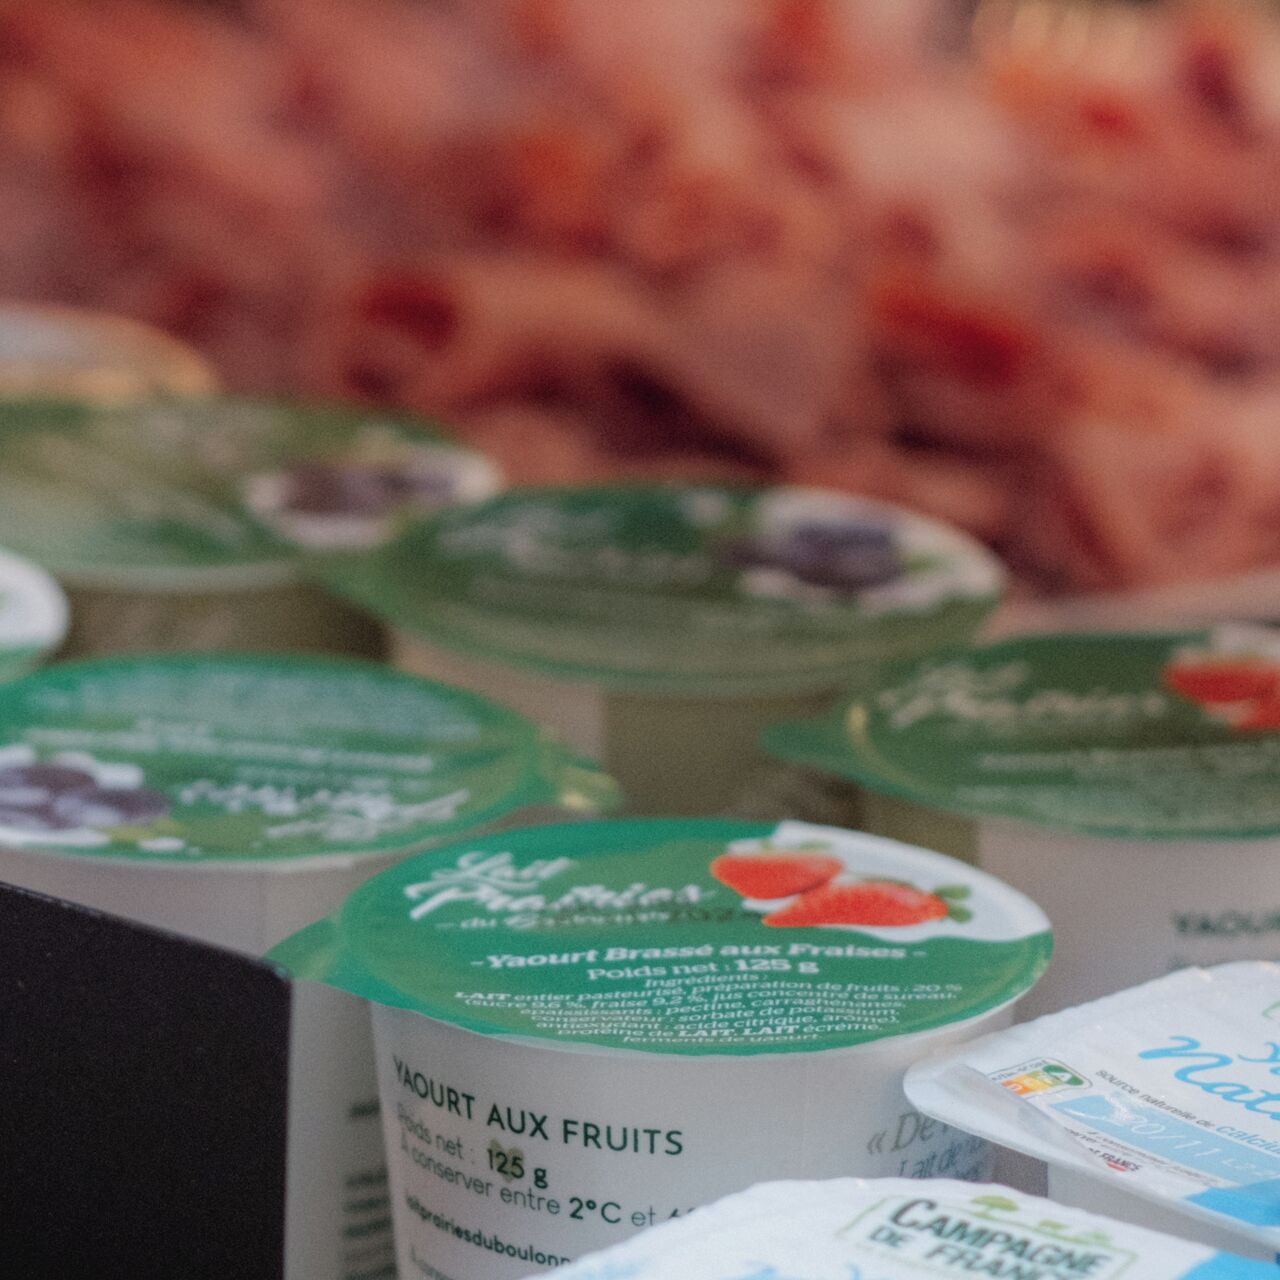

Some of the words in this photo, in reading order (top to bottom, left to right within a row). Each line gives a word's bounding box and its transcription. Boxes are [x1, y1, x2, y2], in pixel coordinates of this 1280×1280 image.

[603, 943, 714, 962] Brassé
[719, 944, 782, 956] aux
[787, 942, 907, 959] Fraises
[586, 965, 667, 981] Poids
[672, 961, 718, 975] net
[734, 958, 792, 972] 125
[797, 961, 820, 975] g
[645, 973, 761, 989] Ingrédients
[454, 990, 512, 1001] LAIT
[513, 991, 572, 1003] entier
[691, 980, 813, 996] préparation
[818, 981, 837, 992] de
[845, 982, 900, 994] fruits
[591, 998, 648, 1010] fraise
[712, 991, 744, 1003] jus
[742, 1024, 801, 1037] LAIT
[392, 1054, 477, 1121] YAOURT
[486, 1103, 550, 1142] AUX
[561, 1118, 684, 1157] FRUITS
[1095, 1068, 1141, 1096] source
[1215, 1124, 1280, 1154] calciu
[435, 1131, 466, 1158] net
[486, 1147, 526, 1180] 125
[533, 1167, 550, 1190] g
[411, 1148, 493, 1199] conserver
[499, 1185, 561, 1216] entre
[568, 1197, 623, 1225] 2°C
[630, 1205, 658, 1228] et
[868, 1225, 916, 1248] DE
[888, 1197, 1114, 1275] CAMPAGNE
